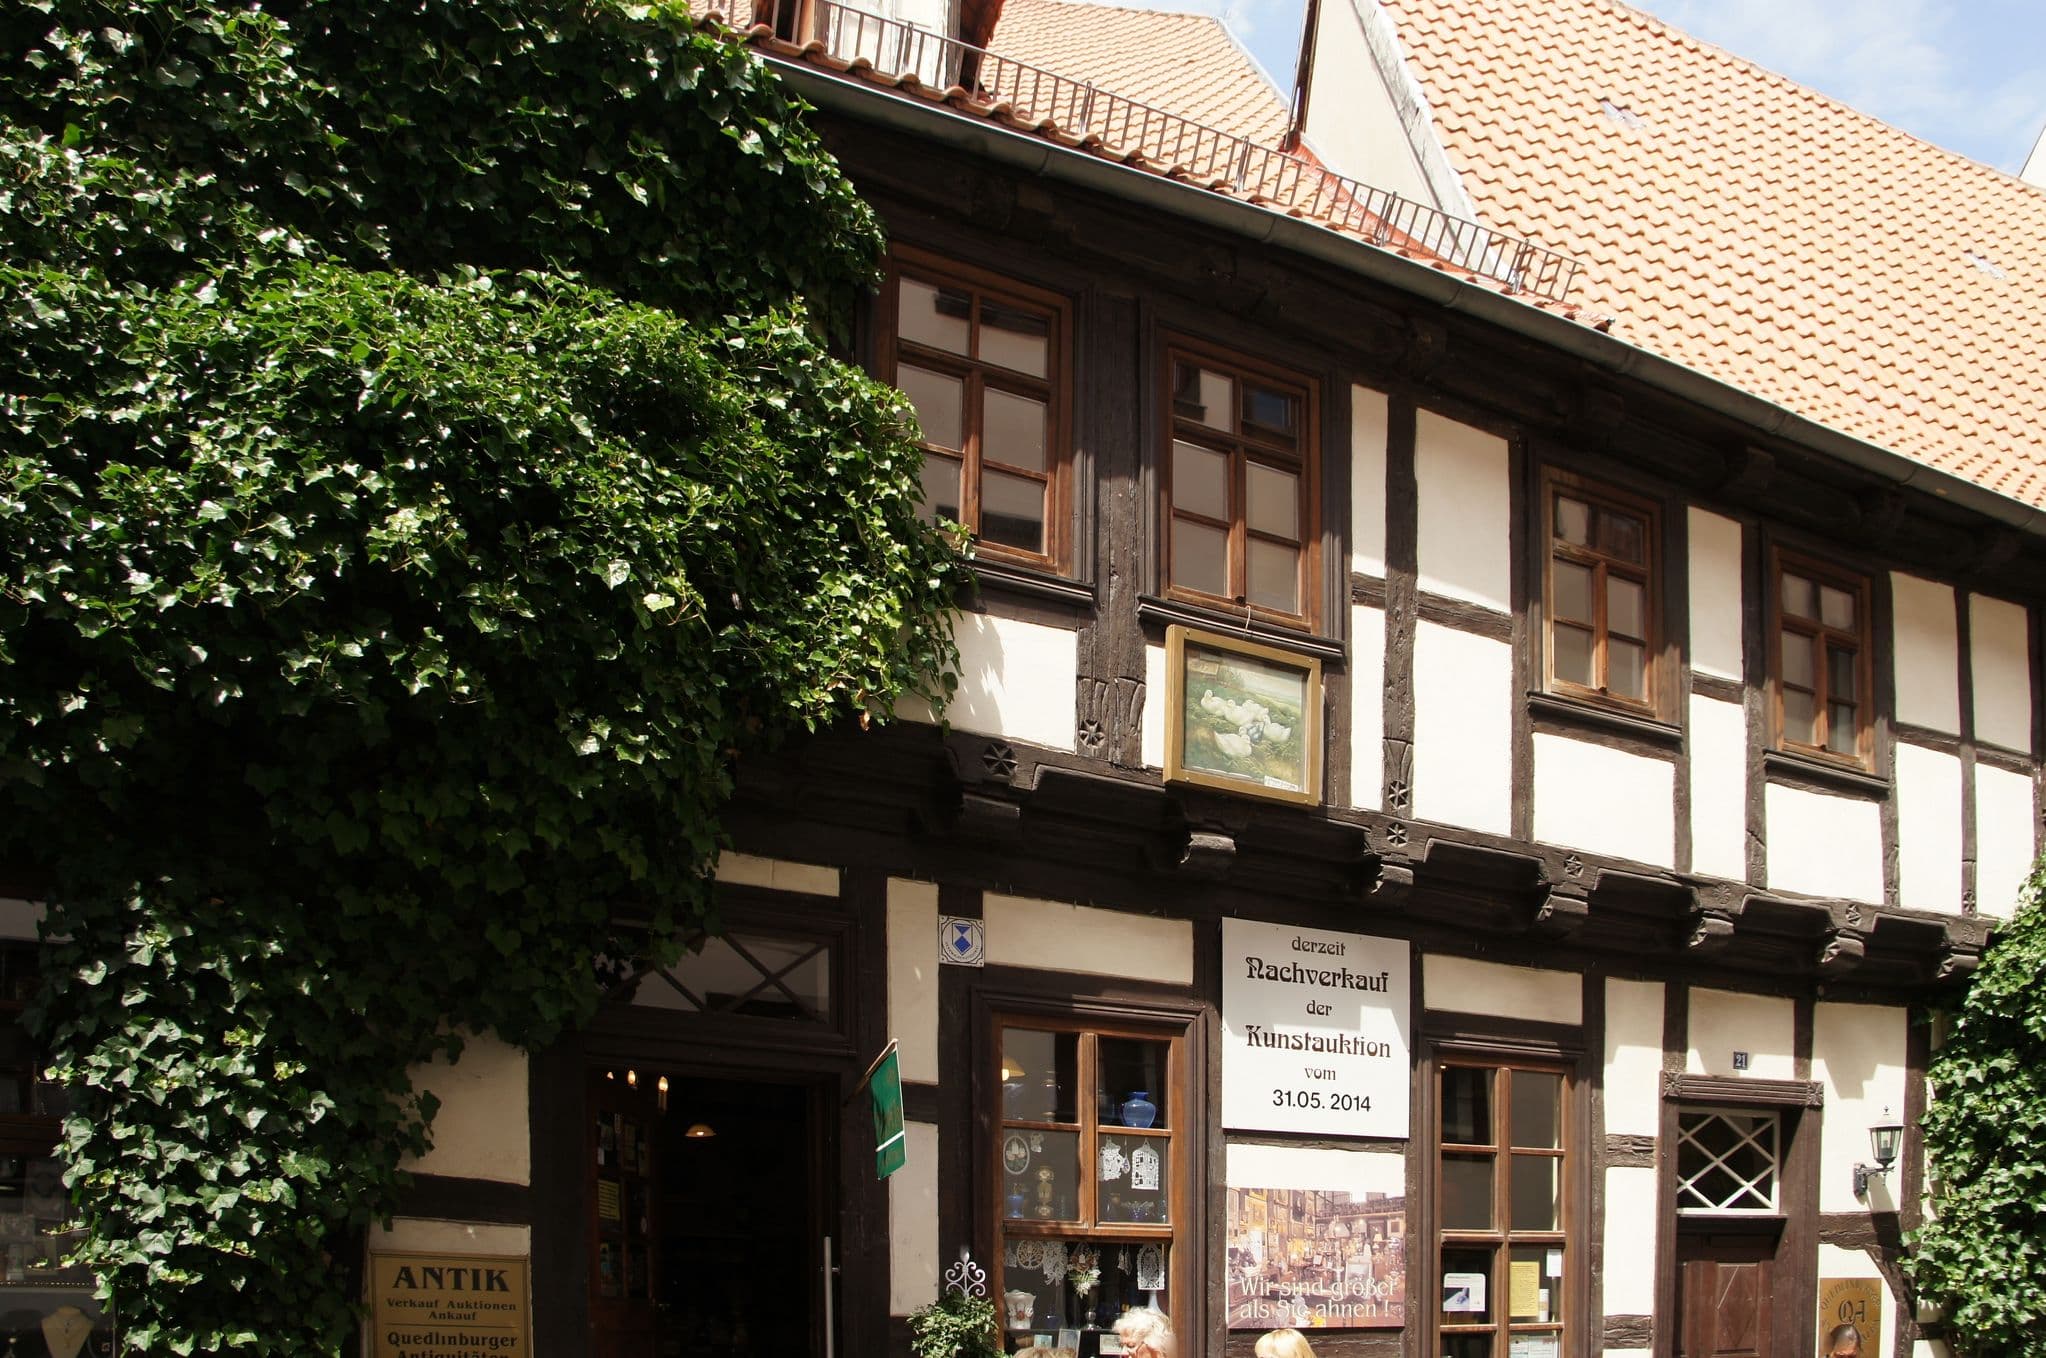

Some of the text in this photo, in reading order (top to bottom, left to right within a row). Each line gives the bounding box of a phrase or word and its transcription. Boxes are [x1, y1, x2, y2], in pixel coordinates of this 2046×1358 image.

[1291, 936, 1346, 956] derzeit
[1245, 956, 1389, 993] Nachverkauf
[1306, 1000, 1333, 1016] der
[1245, 1025, 1391, 1058] Kunstauktion
[1735, 1054, 1746, 1068] 21
[1304, 1066, 1336, 1081] vom
[1330, 1093, 1372, 1112] 2014
[392, 1265, 510, 1292] ANTIK
[1240, 1276, 1397, 1301] Wir sind größer
[387, 1298, 516, 1311] Verkauf Auktionen
[1240, 1299, 1270, 1319] als
[1277, 1299, 1309, 1319] Sie
[1315, 1299, 1377, 1318] ahnen
[428, 1311, 477, 1321] Ankauf
[387, 1331, 518, 1350] Quedlinburger
